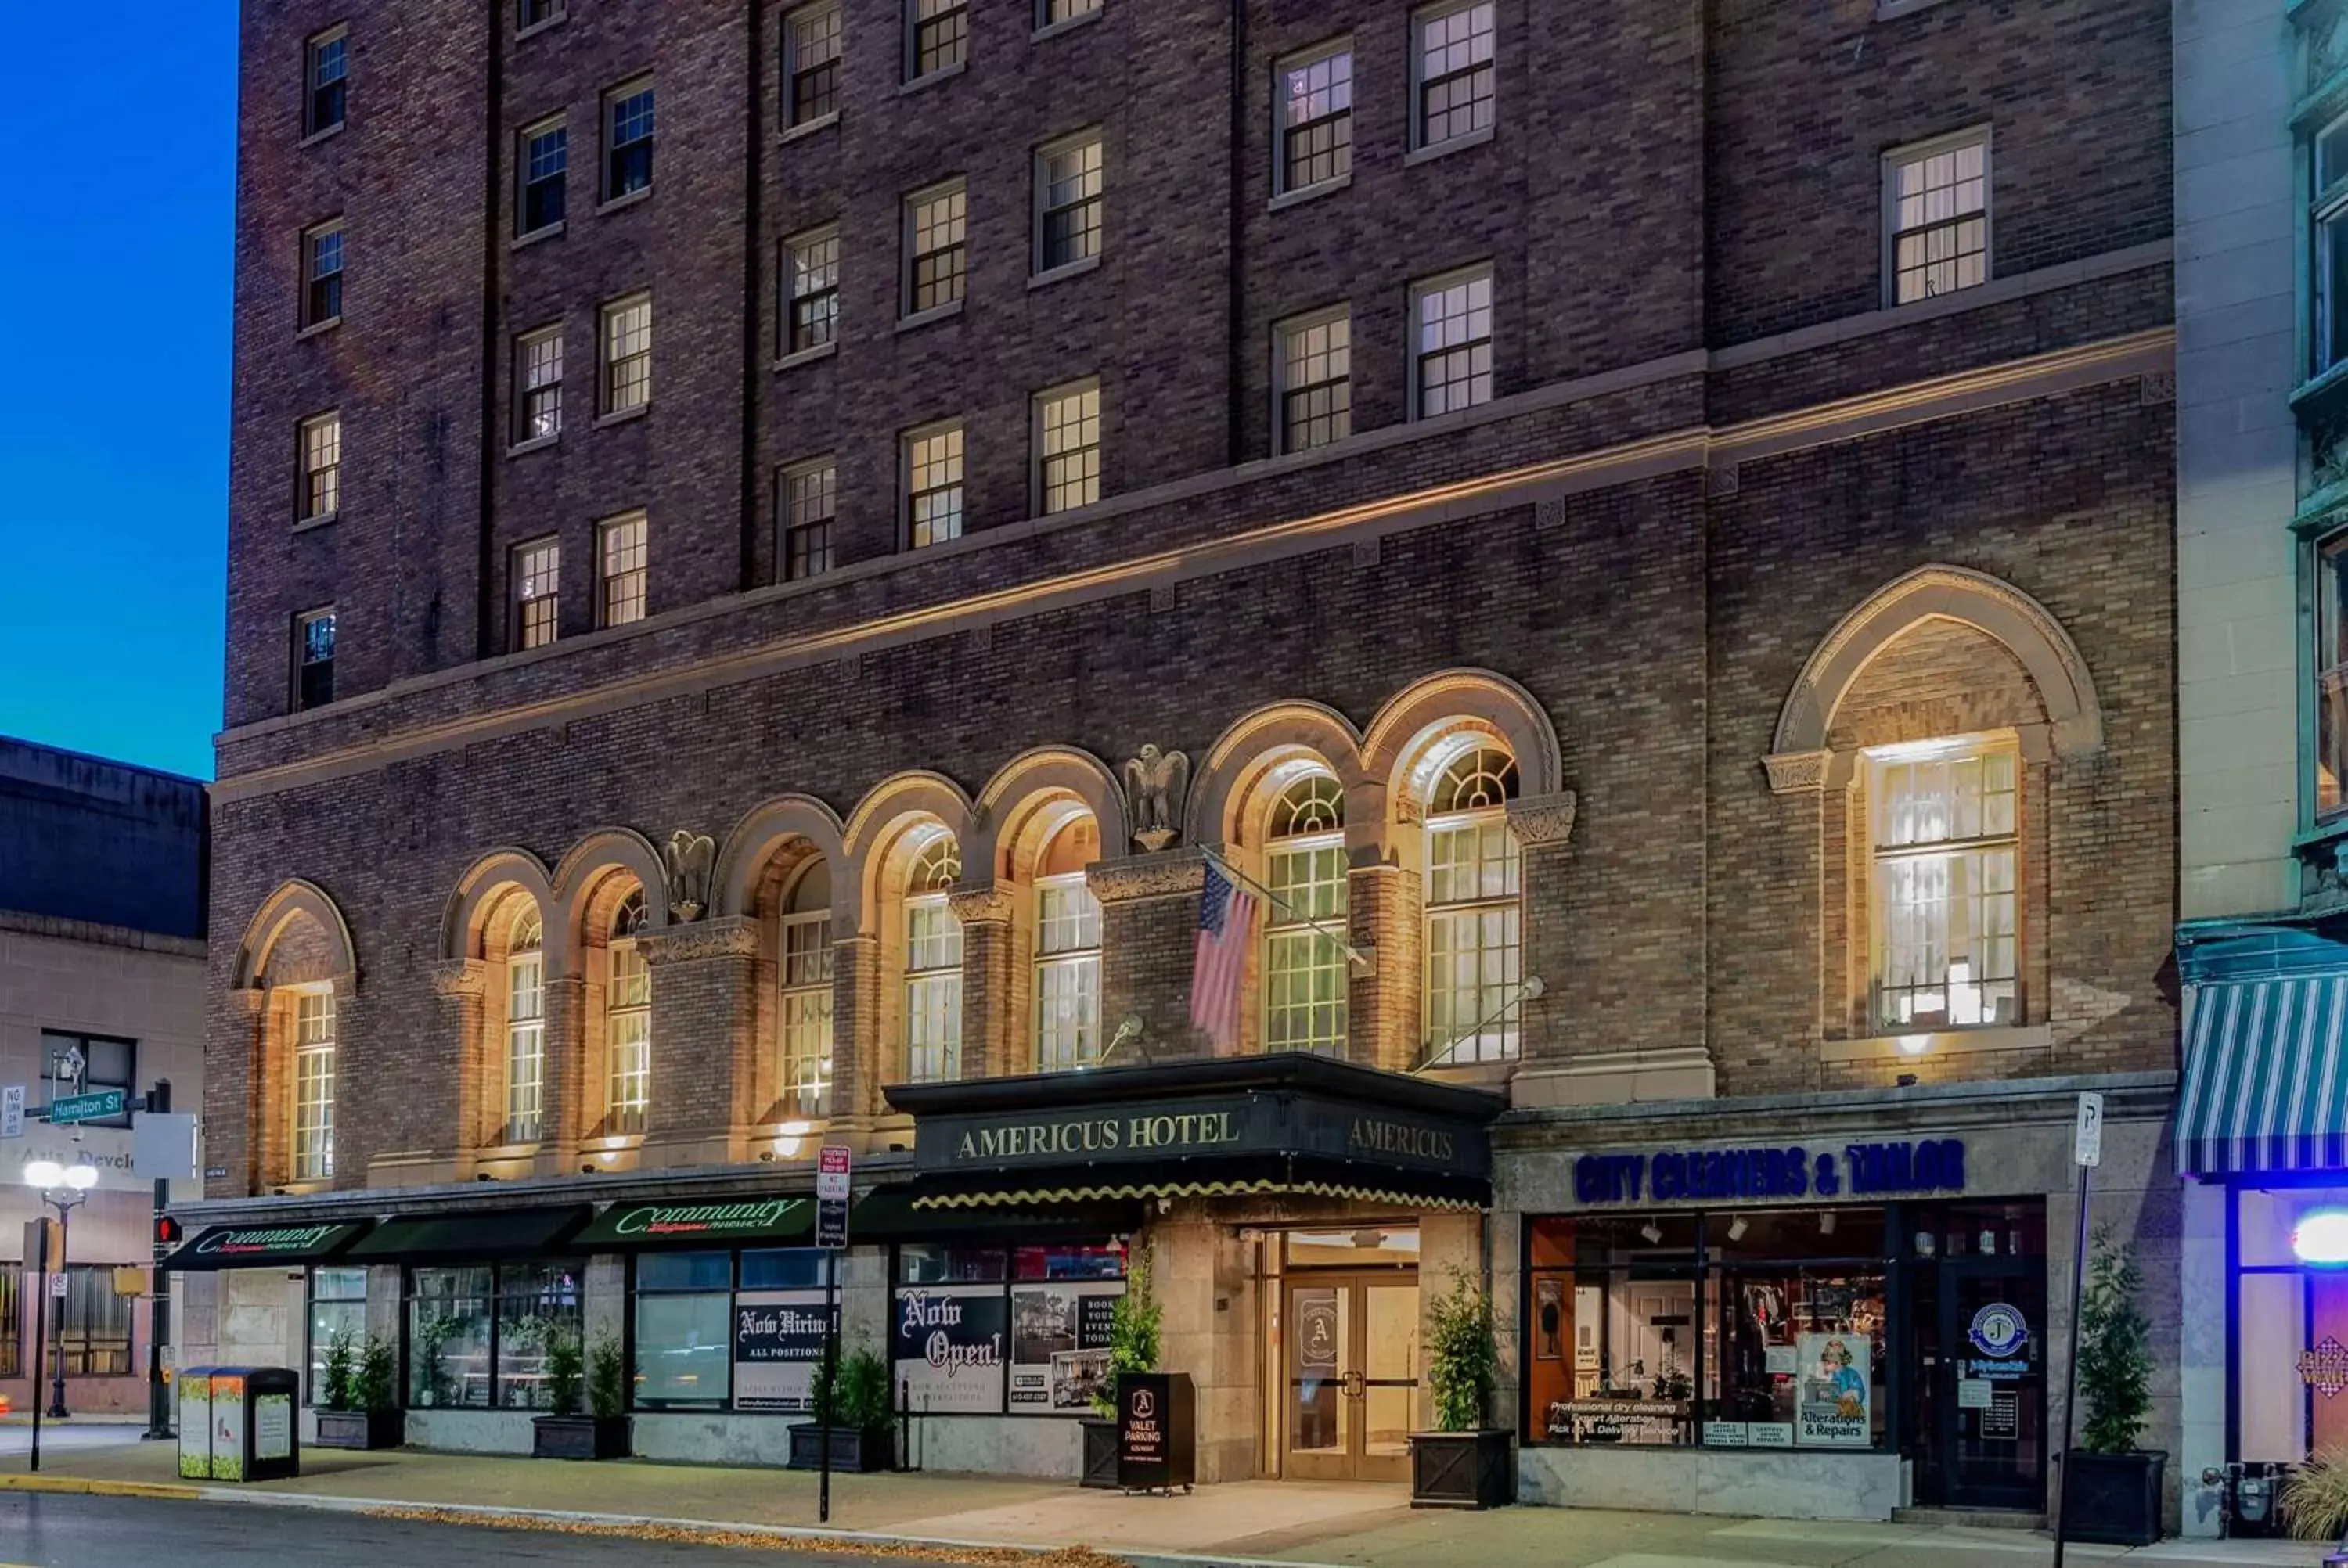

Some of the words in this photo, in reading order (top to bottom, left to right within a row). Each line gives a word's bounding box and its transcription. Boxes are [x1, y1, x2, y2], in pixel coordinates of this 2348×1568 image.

[7, 1091, 20, 1102] NO
[54, 1101, 101, 1117] Hamilton
[106, 1095, 120, 1109] St
[958, 1119, 1119, 1160] AMERICUS
[1127, 1112, 1240, 1149] HOTEL
[1349, 1117, 1453, 1160] AMERICUS
[79, 1149, 134, 1168] Devel
[1576, 1154, 1648, 1203] CITY
[1651, 1146, 1807, 1200] CLEANERS
[1814, 1153, 1839, 1196] &
[1846, 1139, 1964, 1194] TAILOR
[902, 1289, 963, 1339] Now
[739, 1311, 777, 1343] Now
[749, 1348, 768, 1358] ALL
[925, 1329, 1002, 1377] Open!
[1550, 1401, 1612, 1413] Professional
[1614, 1402, 1633, 1413] dry
[1633, 1403, 1677, 1414] cleaning
[1129, 1420, 1157, 1431] VALET
[1801, 1411, 1866, 1426] Alterations
[1125, 1430, 1161, 1443] PARKING
[1805, 1426, 1814, 1436] &
[1816, 1425, 1862, 1440] Repairs
